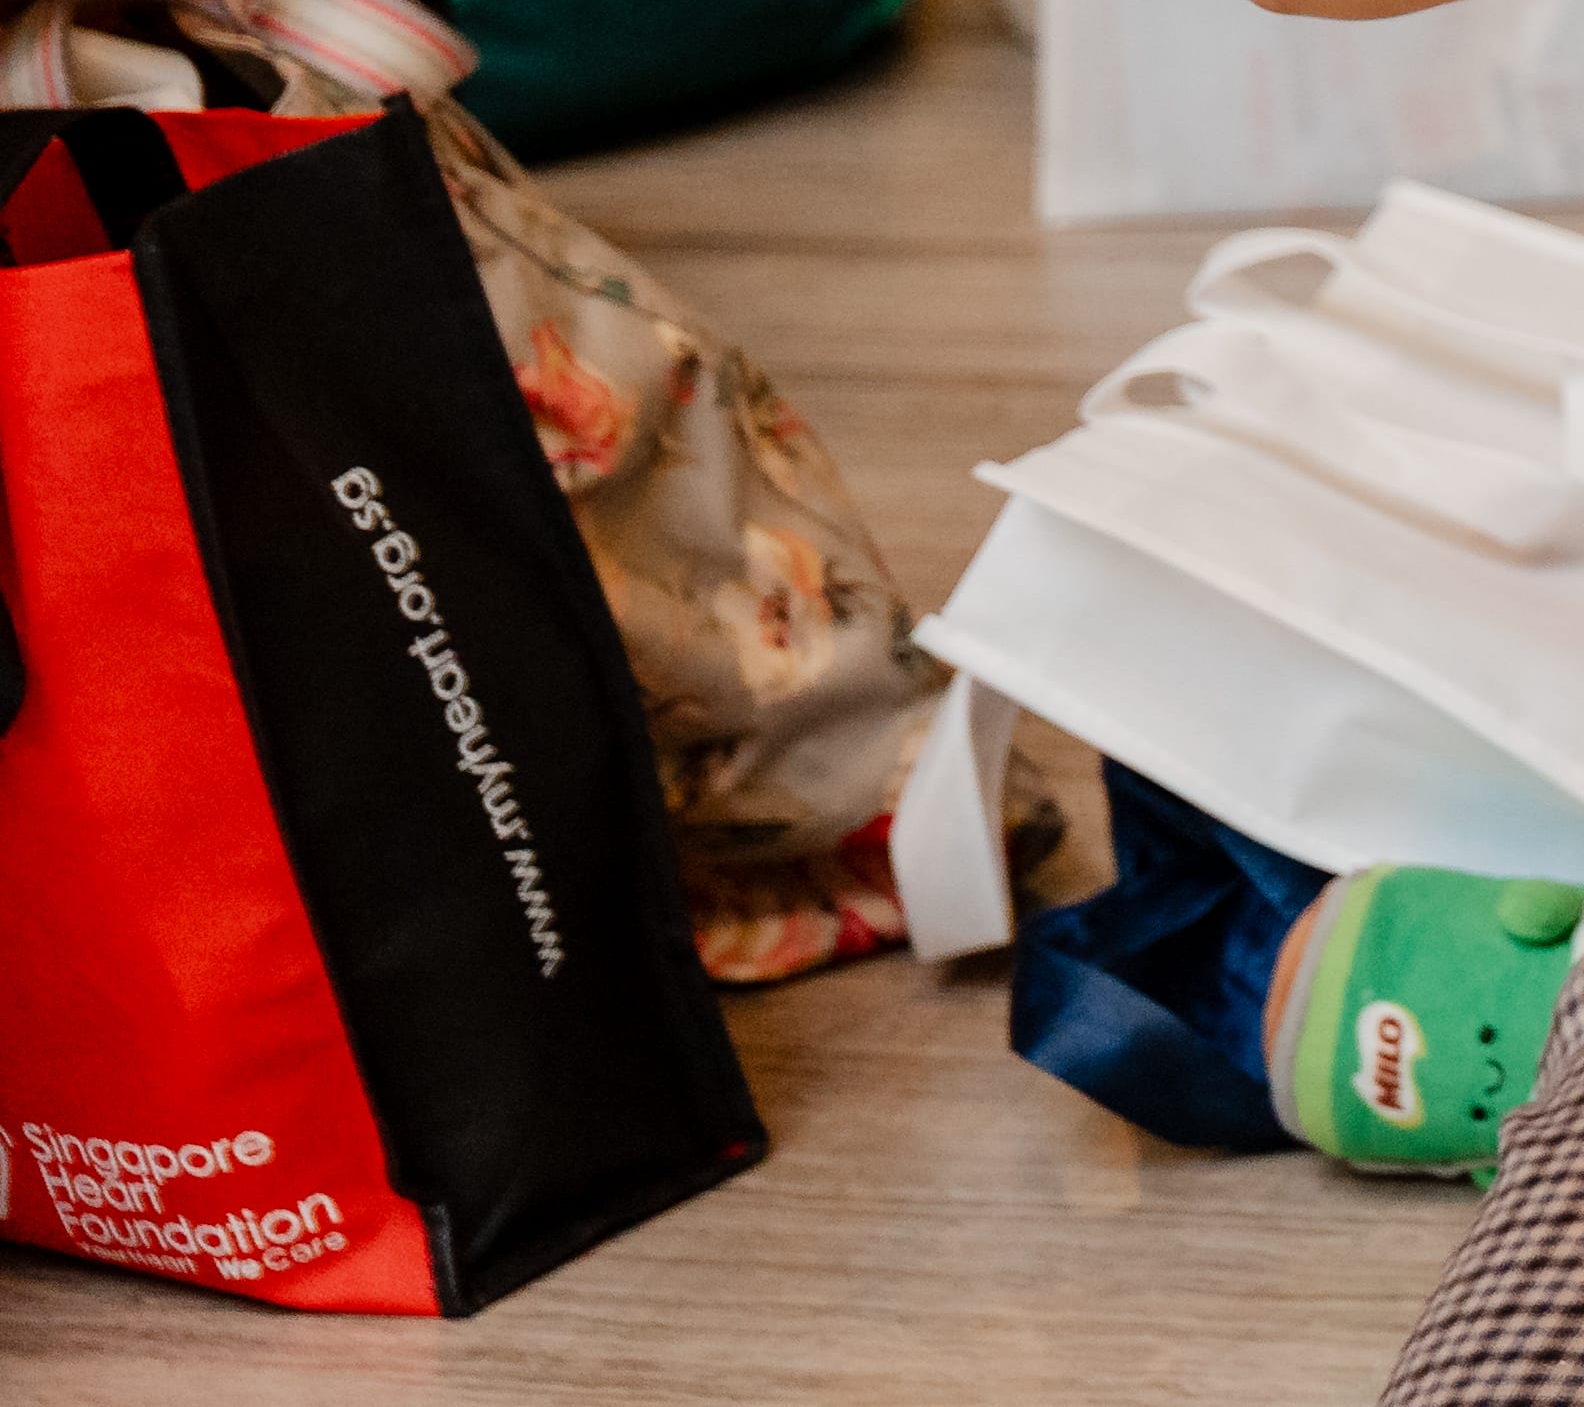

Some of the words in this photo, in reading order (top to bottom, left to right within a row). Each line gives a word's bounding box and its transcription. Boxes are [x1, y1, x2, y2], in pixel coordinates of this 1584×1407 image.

[330, 466, 566, 979] www.myheart.org.sg
[1374, 1016, 1404, 1111] MILO
[21, 1121, 277, 1185] Singapore
[37, 1160, 165, 1215] Heart
[55, 1192, 345, 1259] Foundation
